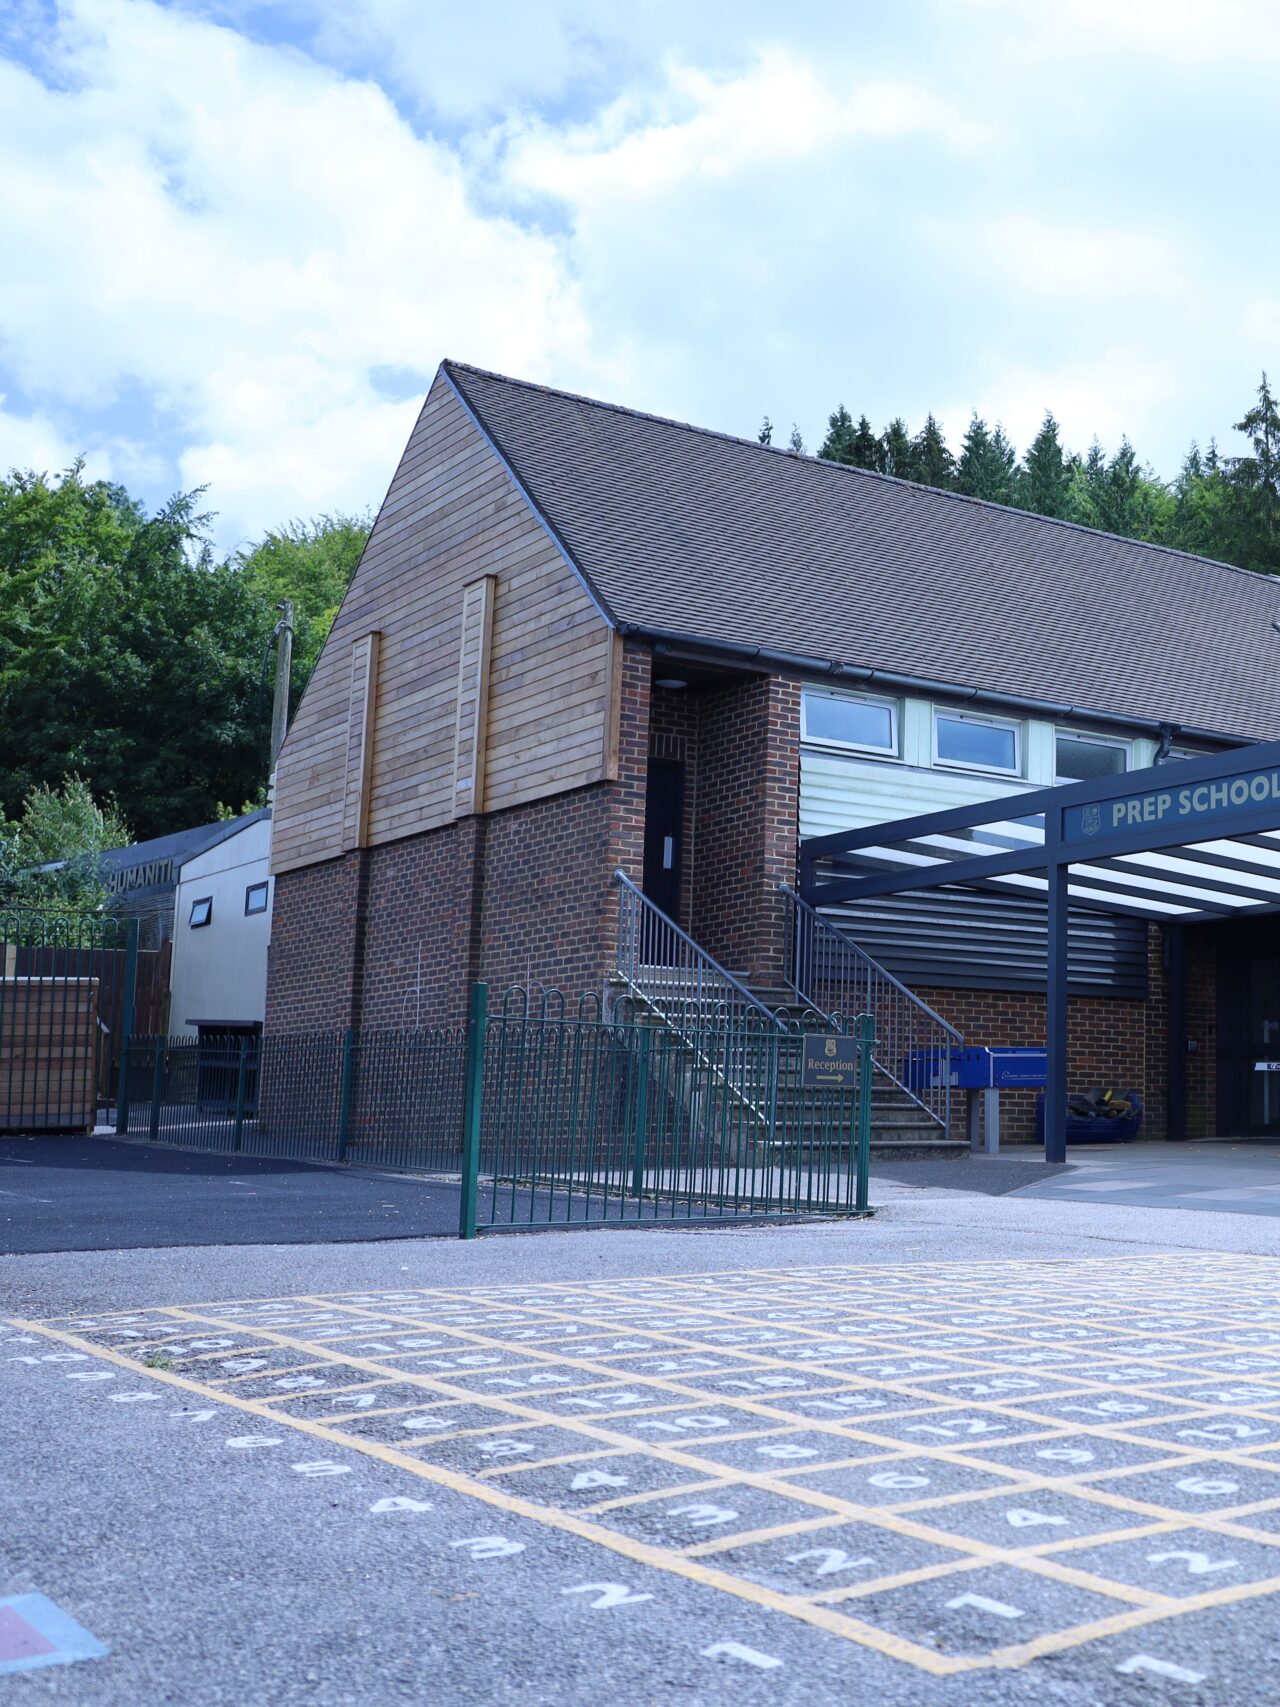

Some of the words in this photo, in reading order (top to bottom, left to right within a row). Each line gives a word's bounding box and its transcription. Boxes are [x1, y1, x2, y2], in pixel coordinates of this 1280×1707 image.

[1112, 794, 1171, 827] PREP
[808, 1058, 853, 1073] Reception
[302, 1322, 393, 1336] 20
[500, 1325, 579, 1338] 27
[704, 1330, 790, 1342] 32
[355, 1338, 444, 1352] 18
[560, 1340, 652, 1355] 24
[778, 1344, 867, 1358] 28
[1107, 1342, 1188, 1354] 36
[8, 1353, 89, 1365] 10
[221, 1358, 268, 1371] 9
[417, 1354, 503, 1368] 16
[640, 1356, 723, 1372] 21
[857, 1361, 952, 1376] 24
[1081, 1368, 1169, 1382] 25
[273, 1376, 328, 1389] 8
[483, 1373, 573, 1387] 14
[718, 1376, 807, 1390] 18
[949, 1378, 1043, 1394] 20
[334, 1393, 378, 1407] 7
[556, 1391, 655, 1409] 12
[797, 1396, 888, 1412] 15
[169, 1410, 217, 1422] 7
[1057, 1400, 1150, 1417] 16
[400, 1416, 456, 1430] 6
[634, 1414, 731, 1433] 10
[902, 1418, 1006, 1438] 12
[1176, 1423, 1270, 1441] 12
[225, 1435, 284, 1448] 6
[474, 1437, 536, 1459] 5
[756, 1444, 821, 1459] 8
[1035, 1448, 1096, 1464] 9
[291, 1460, 352, 1477] 5
[570, 1469, 629, 1488] 4
[866, 1471, 932, 1489] 6
[1174, 1476, 1240, 1495] 6
[369, 1497, 433, 1513] 4
[667, 1500, 739, 1526] 3
[1003, 1509, 1070, 1528] 4
[447, 1536, 527, 1559] 3
[786, 1548, 877, 1575] 2
[1144, 1549, 1240, 1574] 2
[560, 1582, 654, 1608] 2
[945, 1591, 1024, 1619] 1
[700, 1641, 784, 1669] 1
[1115, 1654, 1206, 1684] 1
